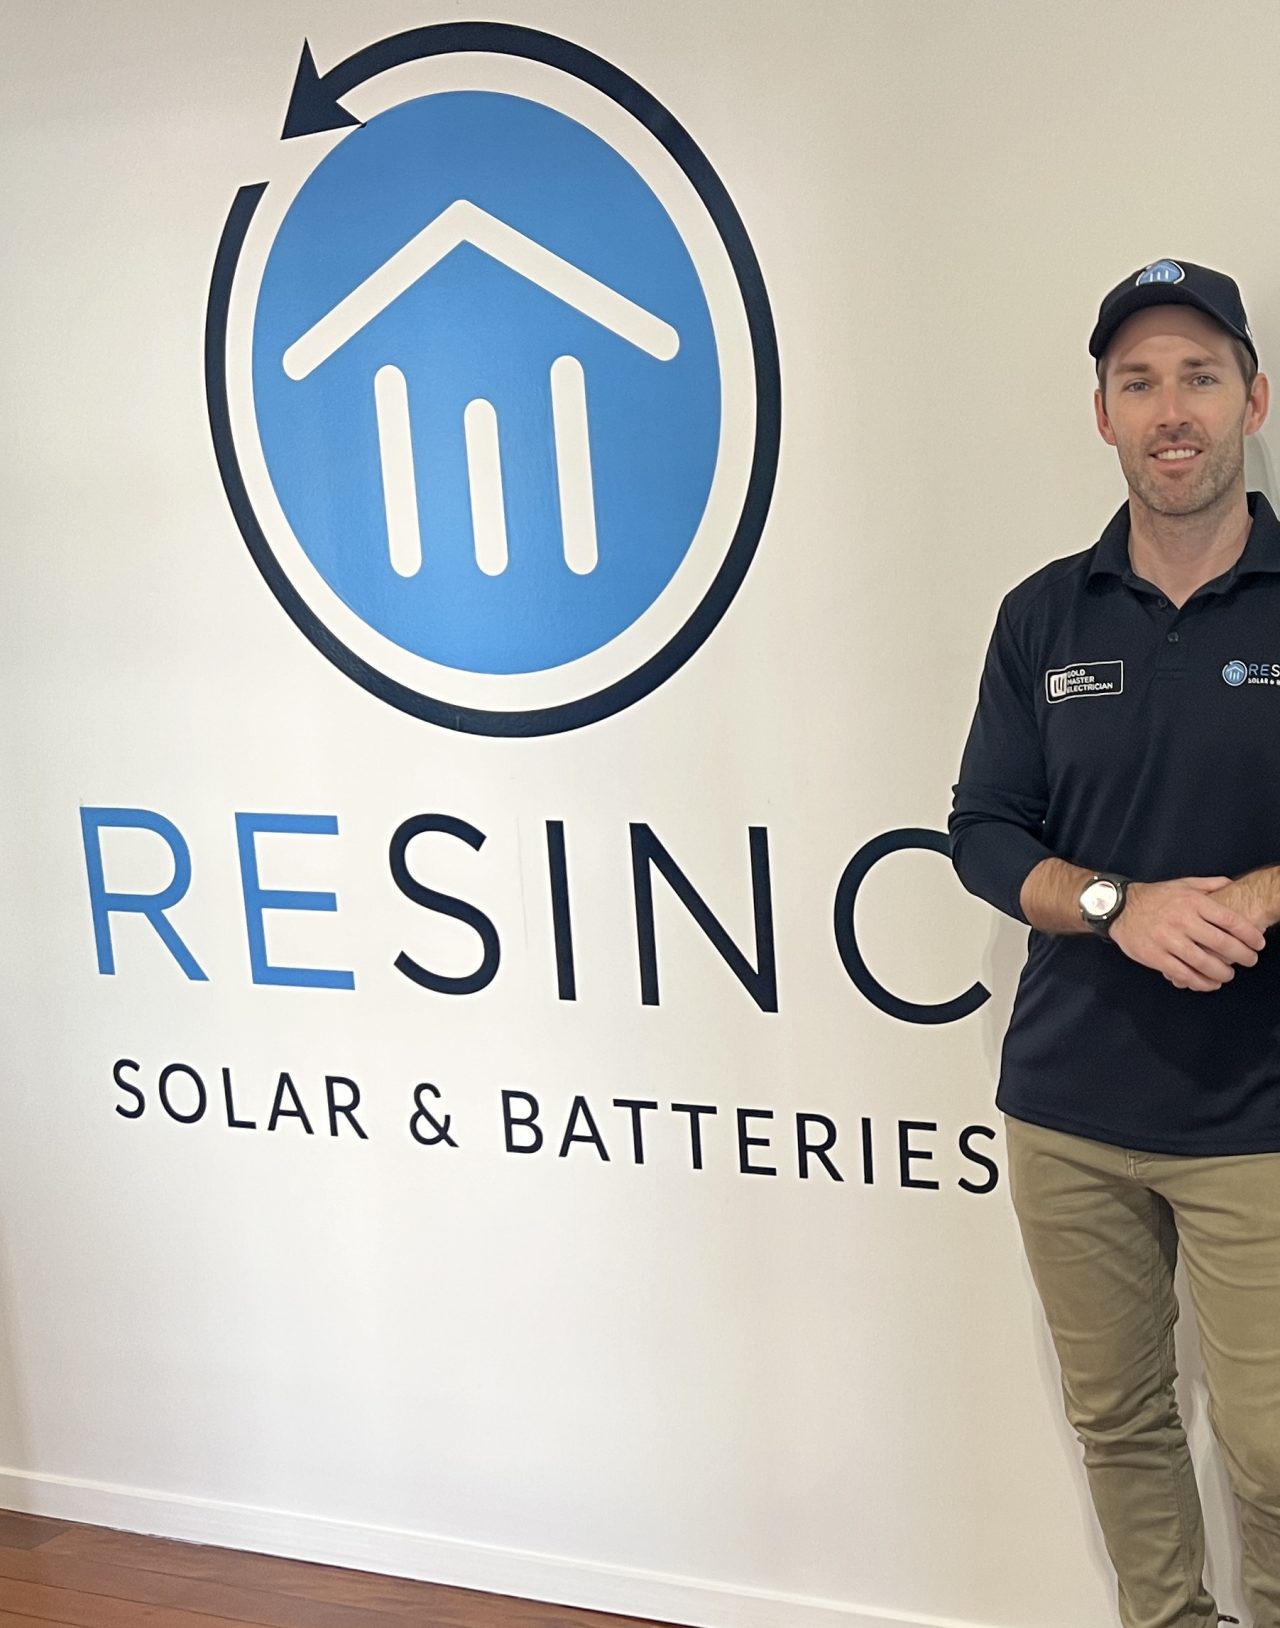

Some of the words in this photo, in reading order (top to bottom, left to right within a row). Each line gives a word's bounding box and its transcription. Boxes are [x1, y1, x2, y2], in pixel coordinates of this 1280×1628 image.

[1067, 682, 1113, 693] ELECTRICIAN
[80, 807, 991, 1024] RESINC
[113, 1059, 368, 1139] SOLAR
[410, 1083, 458, 1147] &
[502, 1090, 999, 1194] BATTERIES
